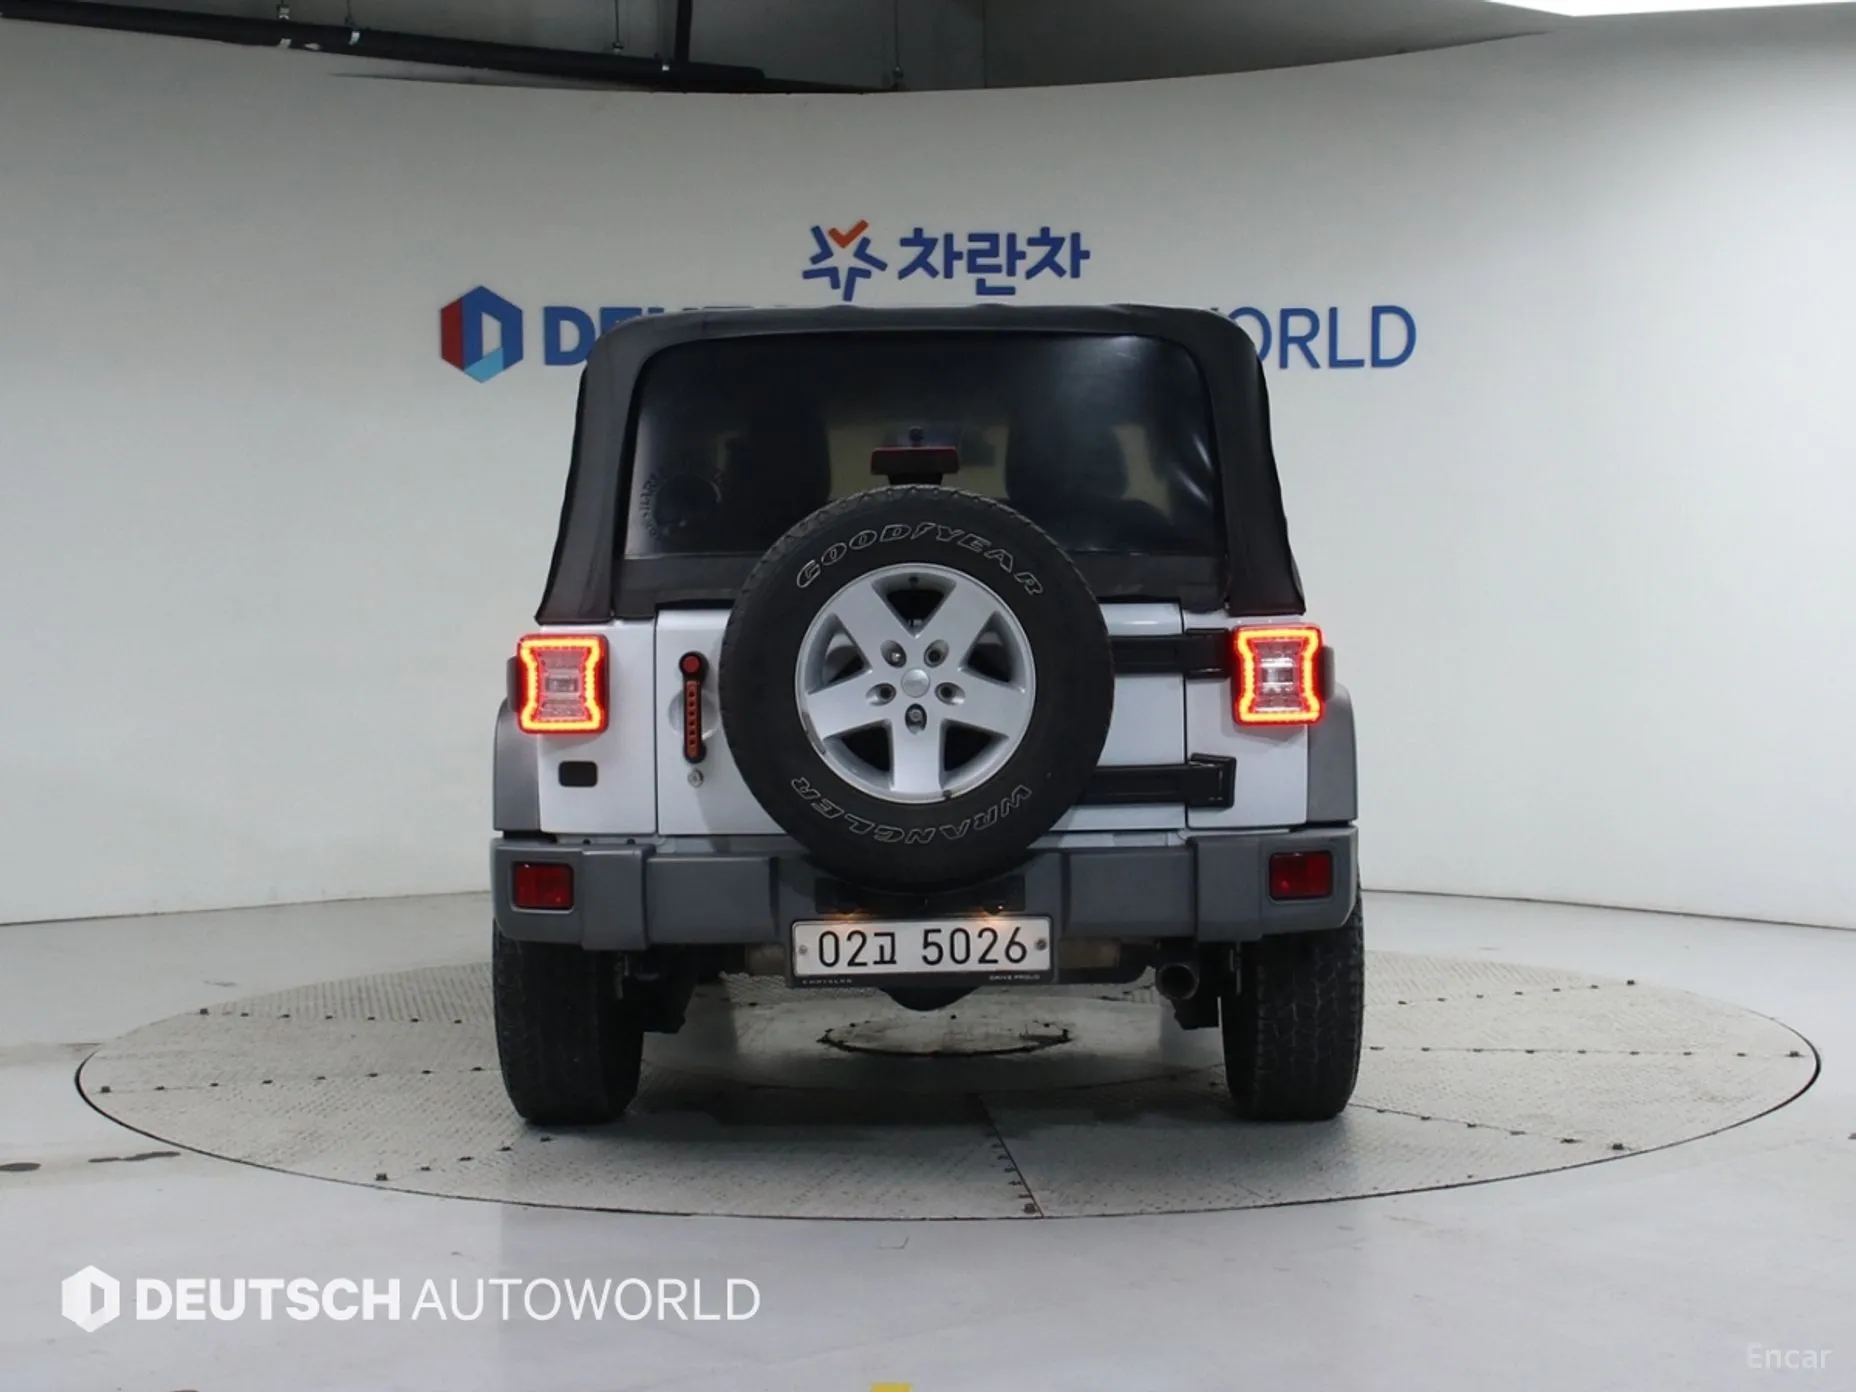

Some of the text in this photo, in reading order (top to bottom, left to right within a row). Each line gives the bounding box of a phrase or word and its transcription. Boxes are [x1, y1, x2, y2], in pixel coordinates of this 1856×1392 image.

[898, 227, 1090, 296] 차란차
[791, 777, 1032, 844] WRANGLER
[818, 927, 1027, 968] 02고 5026
